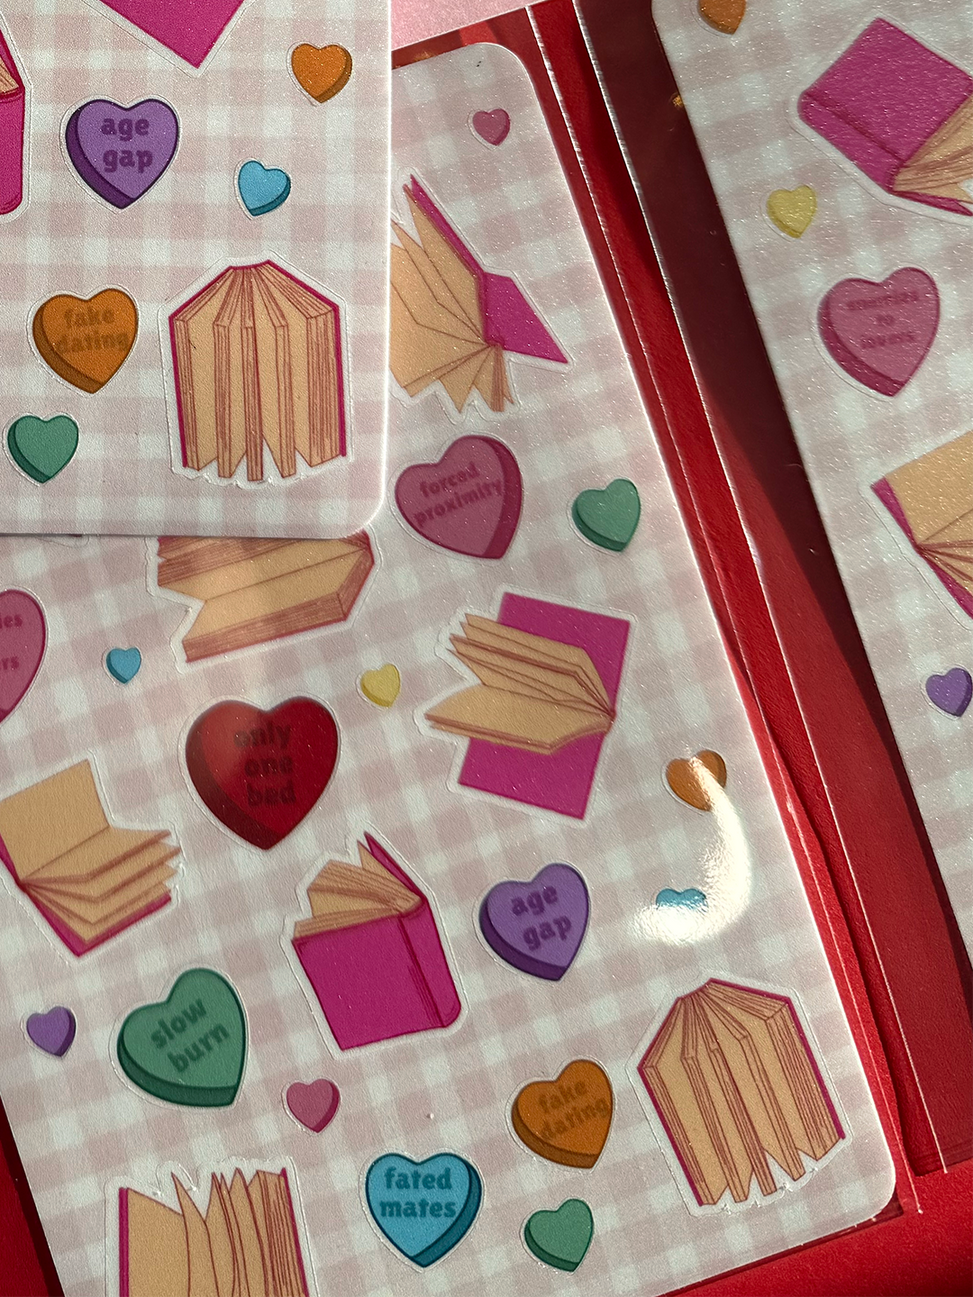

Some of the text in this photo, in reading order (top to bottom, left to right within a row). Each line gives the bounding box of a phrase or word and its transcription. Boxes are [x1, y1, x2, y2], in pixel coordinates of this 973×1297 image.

[100, 118, 150, 142] age
[103, 149, 154, 175] gap
[418, 461, 481, 500] forced
[413, 479, 503, 530] proximity
[232, 720, 292, 751] only
[244, 755, 294, 780] one
[246, 781, 298, 808] bed
[511, 885, 558, 917] age
[523, 915, 572, 952] gap
[150, 996, 208, 1051] slow
[166, 1023, 231, 1074] burn
[537, 1080, 588, 1116] fake
[539, 1097, 609, 1142] dating
[383, 1165, 453, 1192] fated
[378, 1198, 457, 1220] mates
